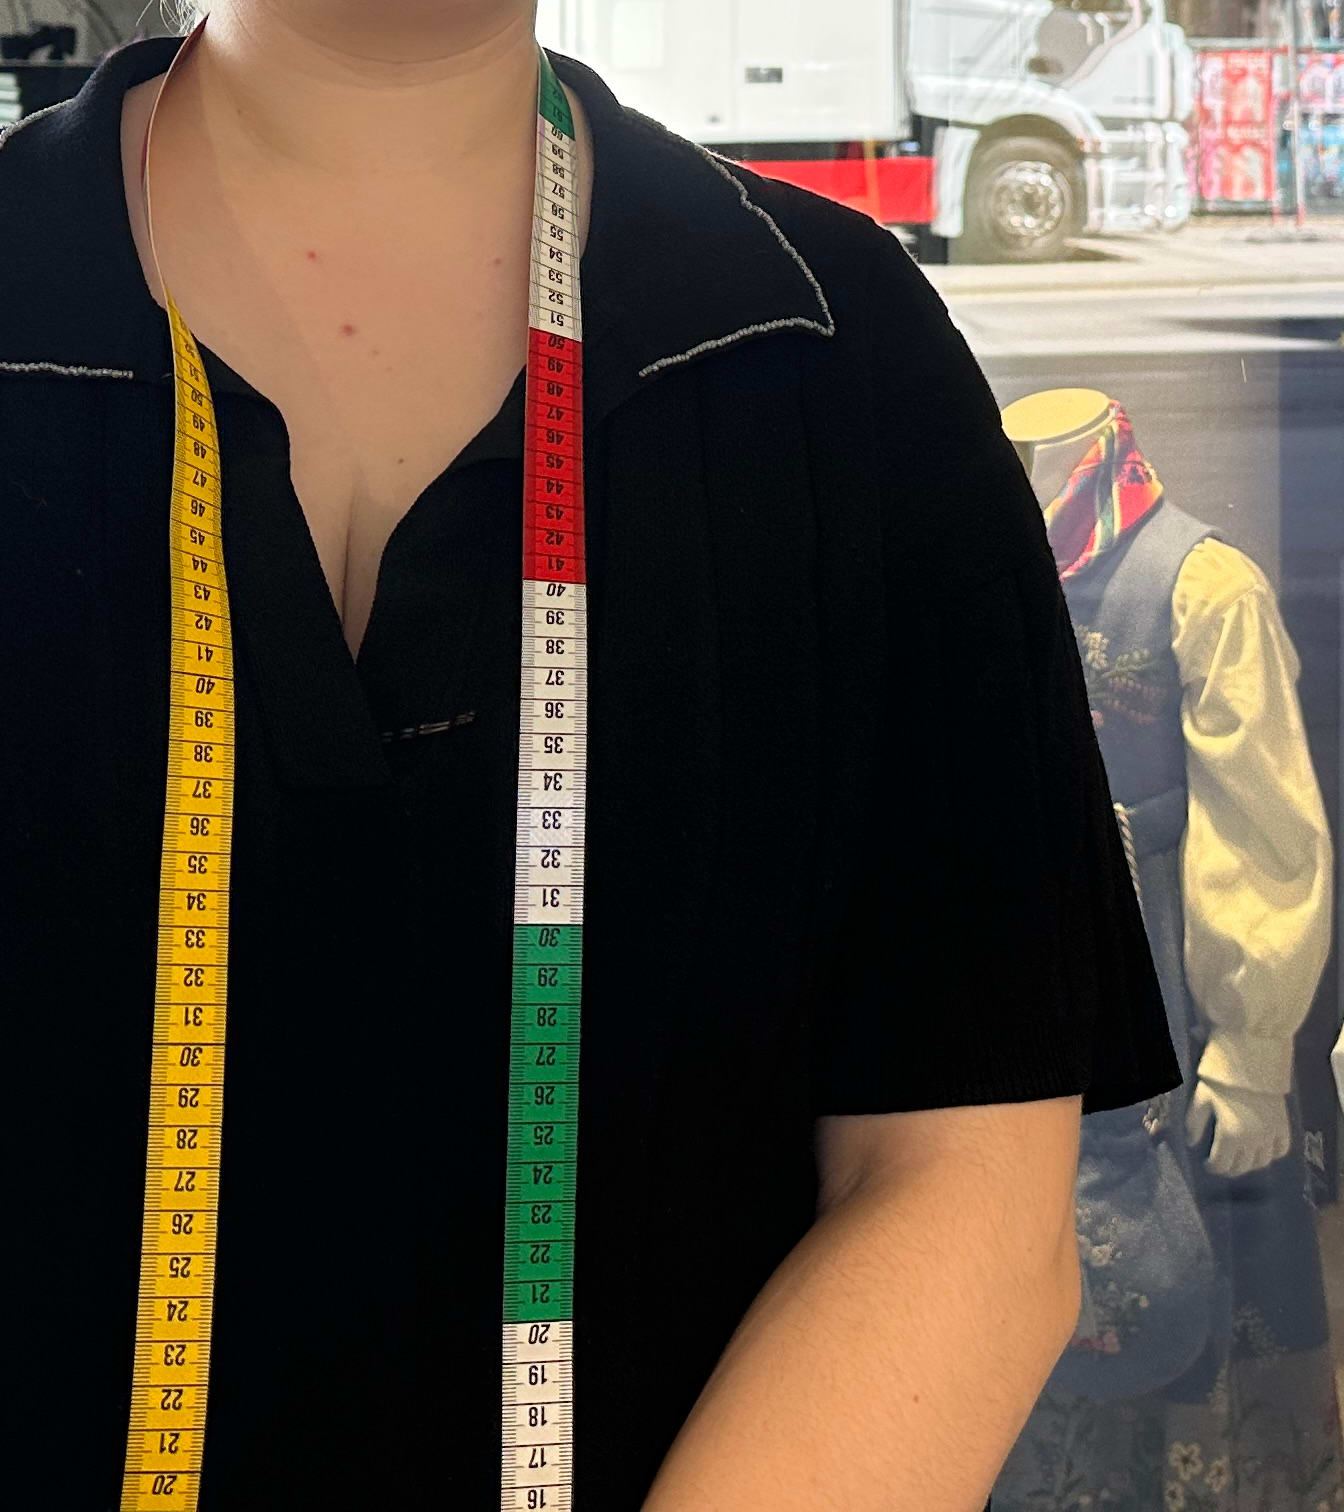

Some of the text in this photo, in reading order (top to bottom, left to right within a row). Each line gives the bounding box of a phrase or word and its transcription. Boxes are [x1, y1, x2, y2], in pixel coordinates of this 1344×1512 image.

[551, 144, 564, 160] 59
[552, 163, 565, 179] 58
[552, 184, 565, 199] 57
[551, 202, 565, 220] 56
[550, 225, 564, 241] 55
[549, 247, 563, 263] 54
[548, 268, 563, 284] 53
[548, 289, 564, 305] 52
[550, 311, 564, 326] 51
[548, 335, 566, 350] 50
[547, 357, 564, 373] 49
[191, 390, 203, 407] 50
[547, 382, 564, 397] 48
[192, 413, 205, 432] 49
[546, 406, 564, 421] 47
[546, 430, 565, 445] 46
[193, 441, 206, 459] 48
[546, 454, 565, 469] 45
[192, 470, 207, 488] 47
[546, 479, 564, 495] 44
[190, 499, 206, 517] 46
[545, 504, 564, 519] 43
[189, 529, 206, 546] 45
[545, 531, 564, 546] 42
[191, 557, 208, 573] 44
[547, 555, 565, 571] 41
[193, 584, 211, 601] 43
[546, 583, 566, 597] 40
[194, 614, 213, 631] 42
[545, 610, 565, 625] 39
[197, 644, 213, 662] 41
[545, 639, 565, 655] 38
[195, 677, 215, 695] 40
[545, 669, 565, 686] 37
[194, 710, 213, 729] 39
[544, 701, 564, 719] 36
[193, 745, 213, 763] 38
[543, 736, 564, 754] 35
[191, 780, 213, 799] 37
[543, 772, 563, 791] 34
[189, 817, 210, 836] 36
[542, 810, 562, 829] 33
[187, 855, 208, 874] 35
[540, 849, 561, 869] 32
[186, 892, 207, 911] 34
[542, 888, 560, 907] 31
[184, 929, 206, 949] 33
[538, 927, 560, 947] 30
[183, 967, 205, 987] 32
[537, 967, 558, 987] 29
[184, 1006, 203, 1027] 31
[536, 1007, 557, 1027] 28
[179, 1046, 203, 1067] 30
[535, 1046, 556, 1066] 27
[177, 1087, 200, 1108] 29
[534, 1085, 555, 1105] 26
[176, 1129, 198, 1150] 28
[533, 1125, 554, 1145] 25
[173, 1170, 196, 1192] 27
[532, 1165, 553, 1185] 24
[531, 1204, 552, 1224] 23
[171, 1213, 194, 1235] 26
[530, 1244, 551, 1264] 22
[169, 1256, 191, 1278] 25
[531, 1283, 550, 1304] 21
[166, 1300, 189, 1322] 24
[528, 1324, 551, 1344] 20
[163, 1344, 187, 1366] 23
[528, 1364, 548, 1385] 19
[160, 1388, 183, 1411] 22
[528, 1406, 548, 1427] 18
[158, 1432, 180, 1454] 21
[528, 1447, 547, 1469] 17
[151, 1475, 177, 1495] 20
[527, 1488, 546, 1509] 16
